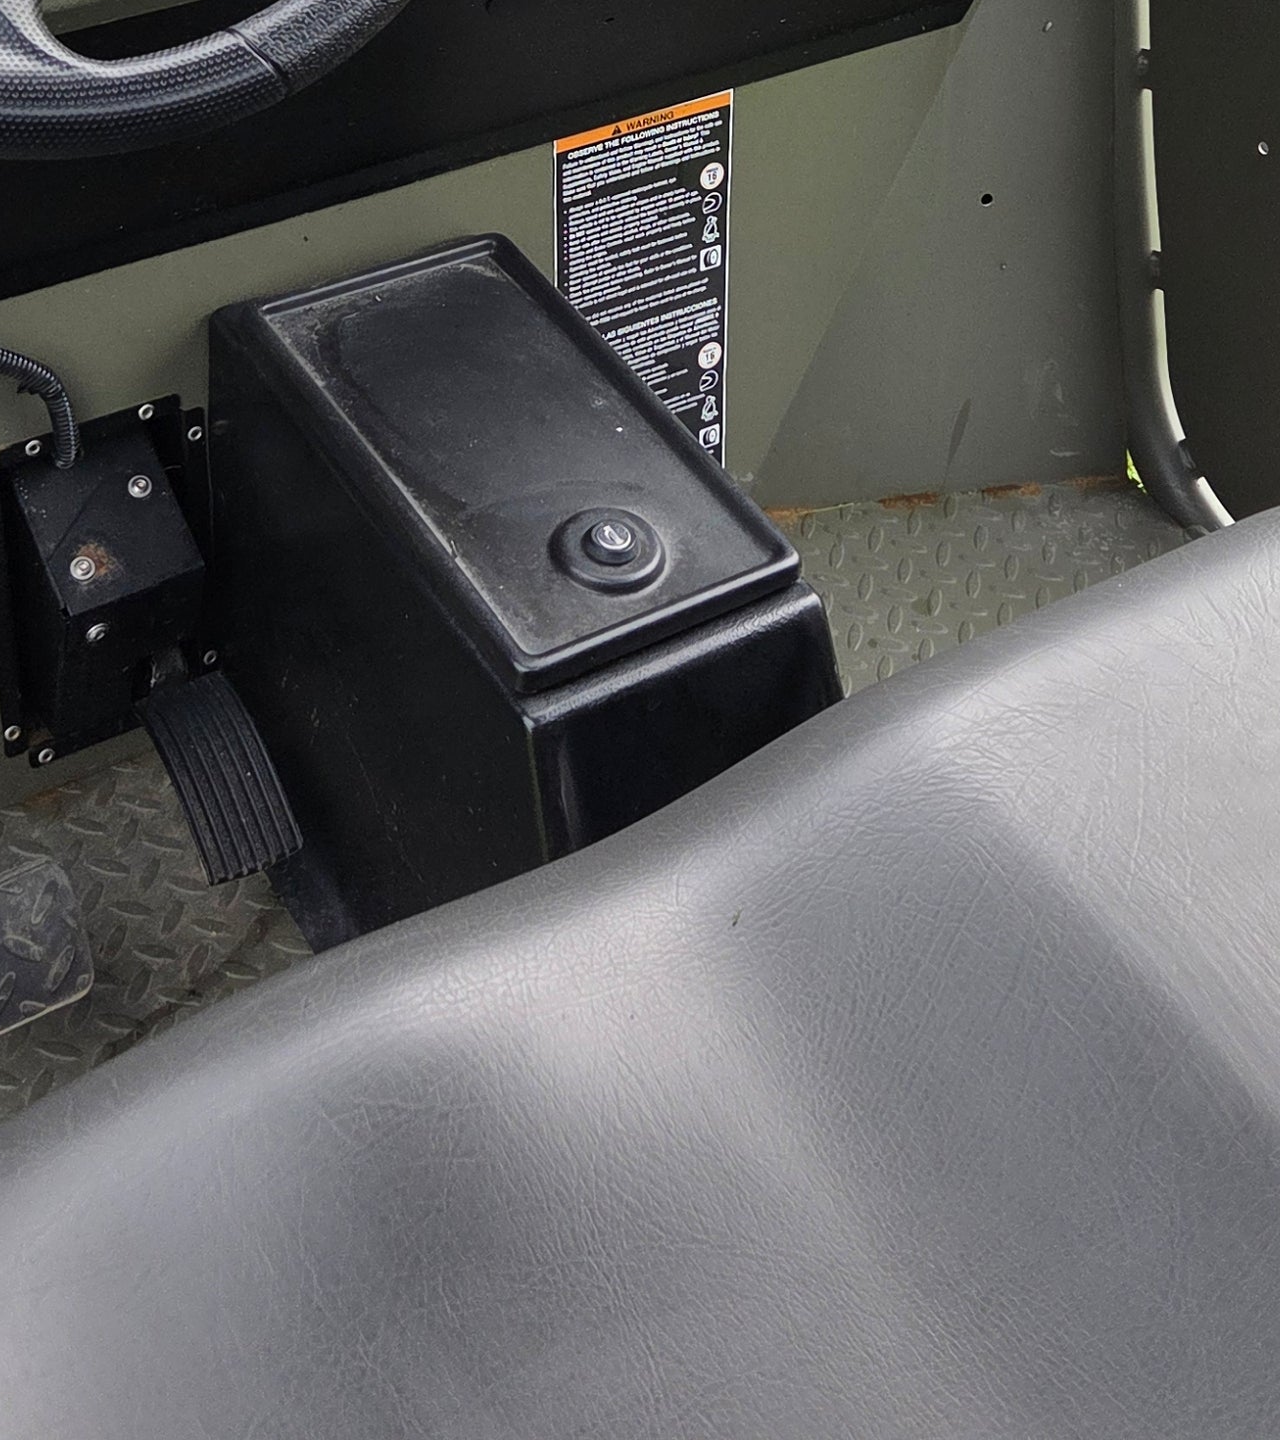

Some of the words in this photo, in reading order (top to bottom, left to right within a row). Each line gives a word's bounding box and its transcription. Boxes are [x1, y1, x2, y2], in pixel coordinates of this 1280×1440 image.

[604, 138, 620, 151] THE
[621, 126, 665, 144] FOLLOWING
[665, 111, 720, 132] INSTRUCTIONS
[626, 111, 674, 131] WARNING
